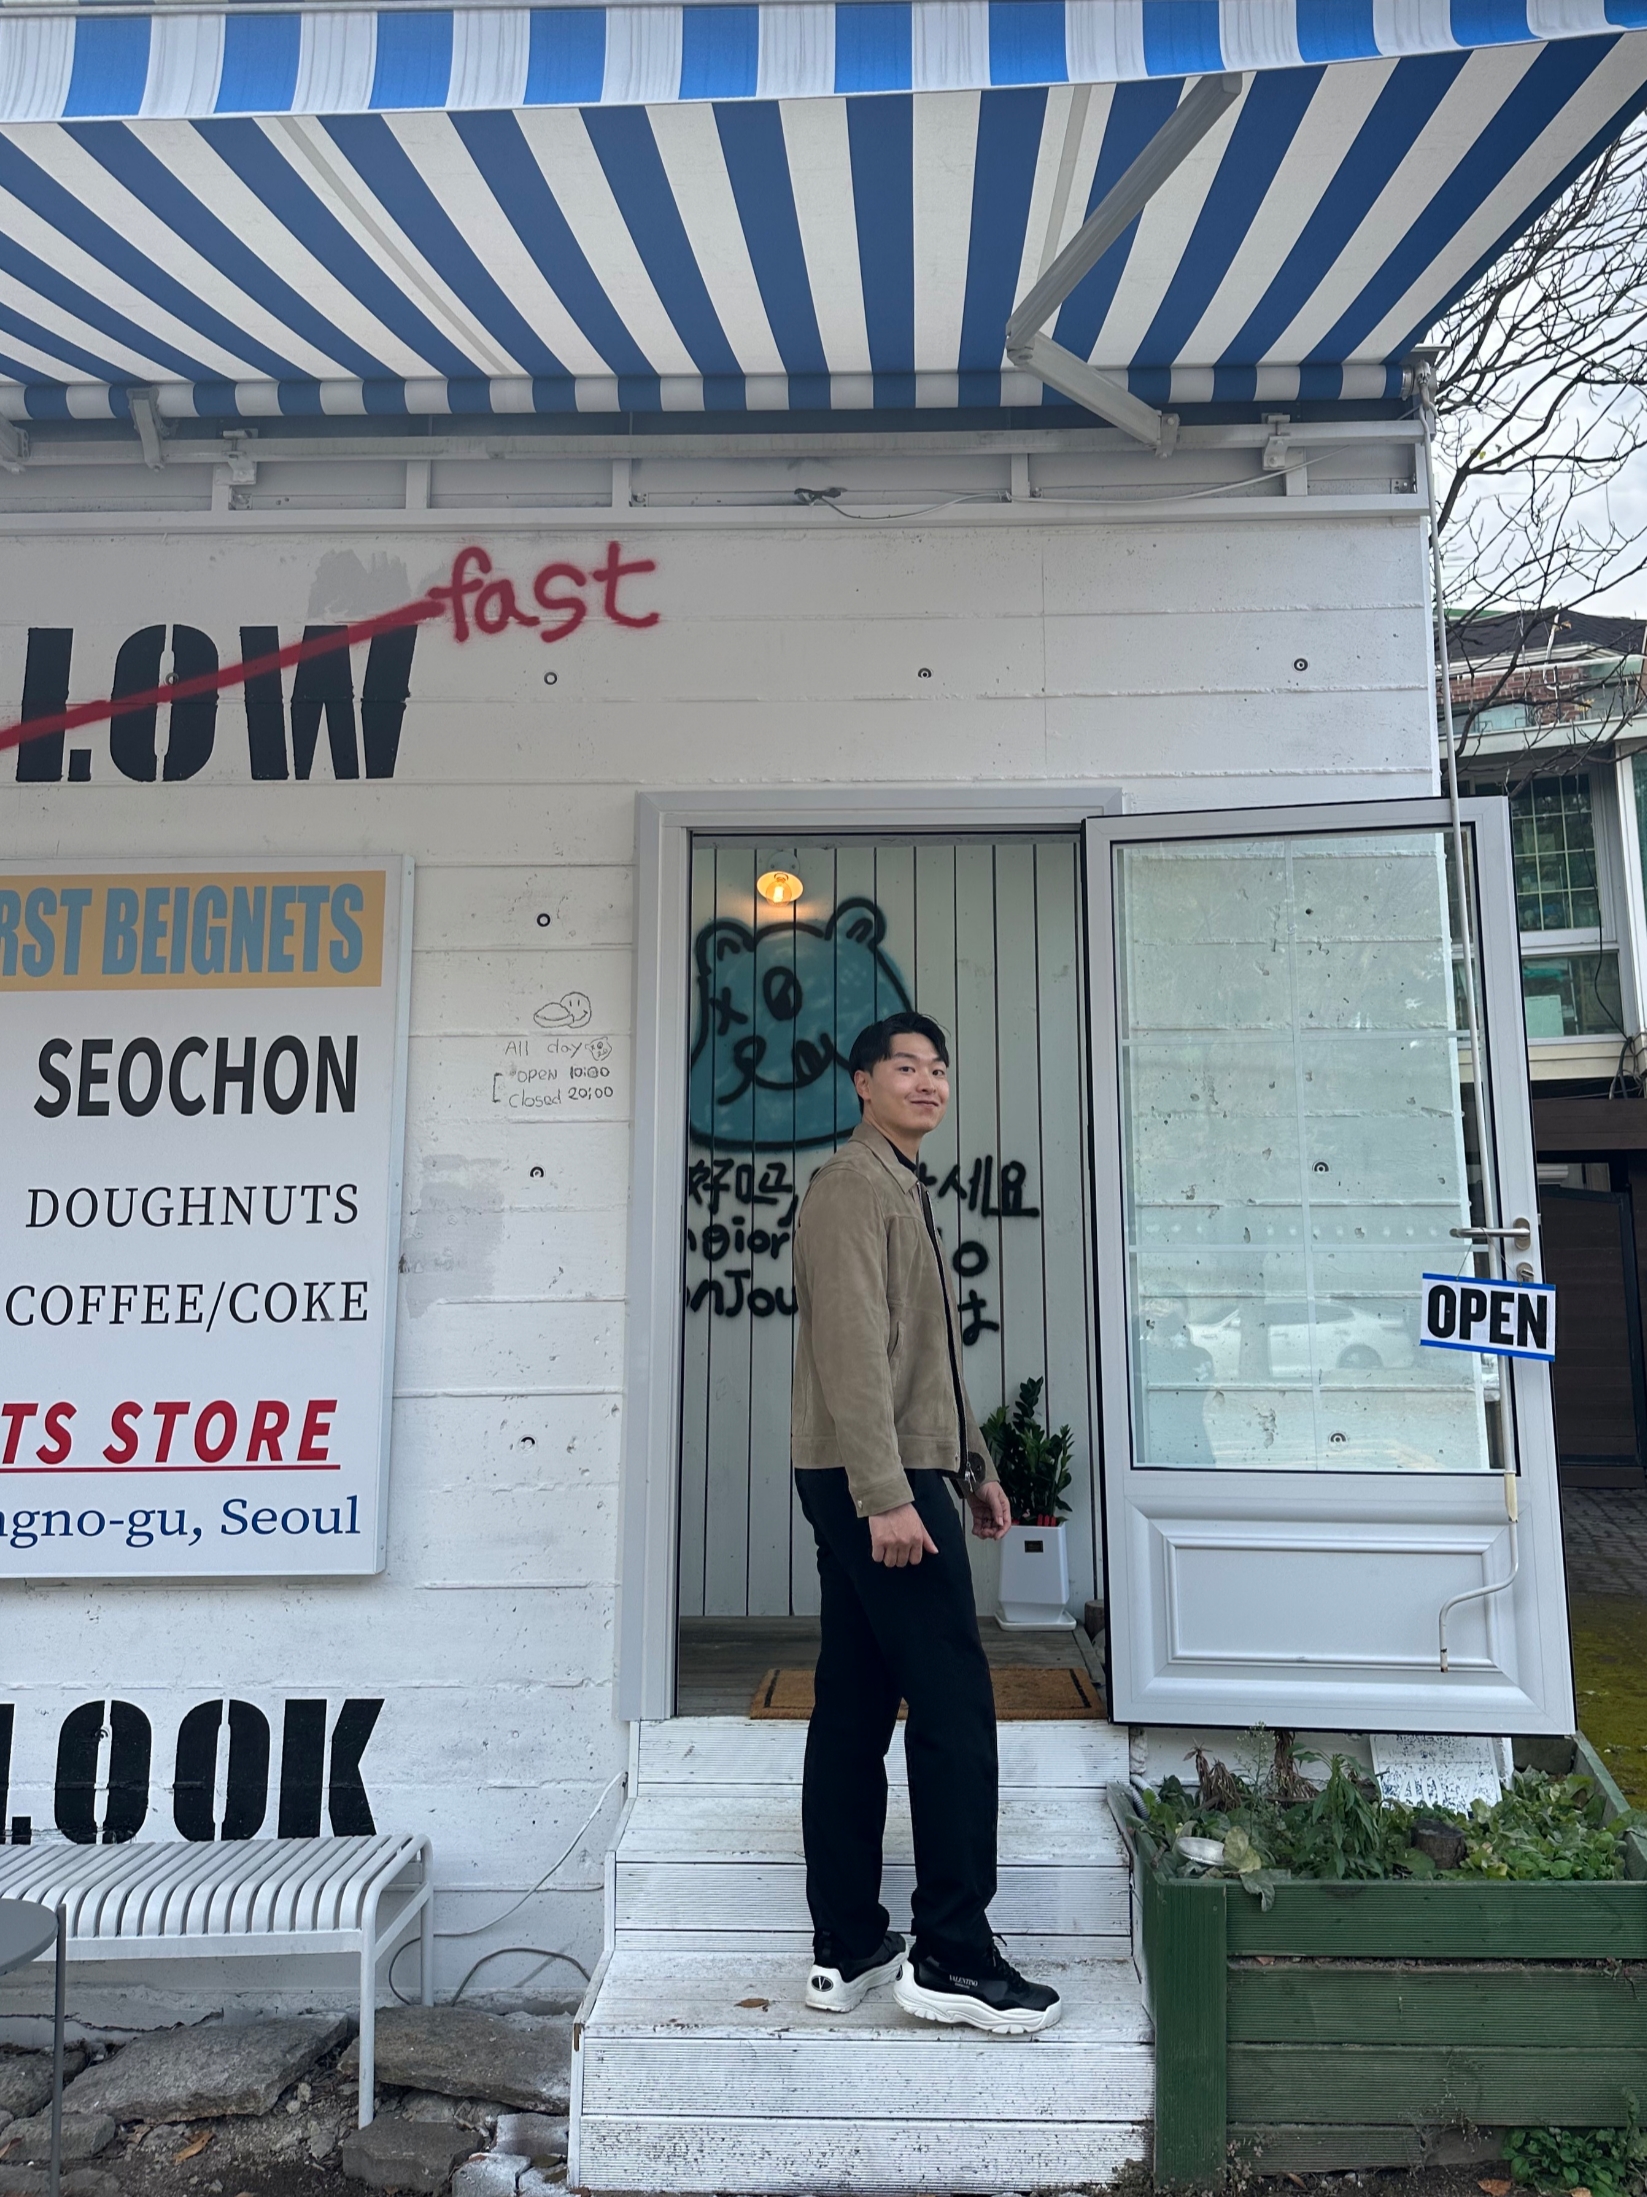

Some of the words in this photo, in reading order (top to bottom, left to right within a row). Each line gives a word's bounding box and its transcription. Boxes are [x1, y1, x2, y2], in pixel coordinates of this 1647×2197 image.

[427, 540, 660, 643] fast
[101, 883, 364, 975] BEIGNETS
[33, 1035, 358, 1118] SEOCHON
[505, 1040, 529, 1057] All
[547, 1038, 582, 1058] day
[570, 1066, 610, 1079] 10:00
[26, 1184, 359, 1228] DOUGHNUTS
[5, 1281, 369, 1332] COFFEE/COKE
[1427, 1284, 1548, 1350] OPEN
[1, 1401, 77, 1464] TS
[102, 1400, 338, 1464] STORE
[0, 1509, 202, 1549] gno-gu,
[220, 1495, 361, 1535] Seoul
[0, 1699, 385, 1844] OOK
